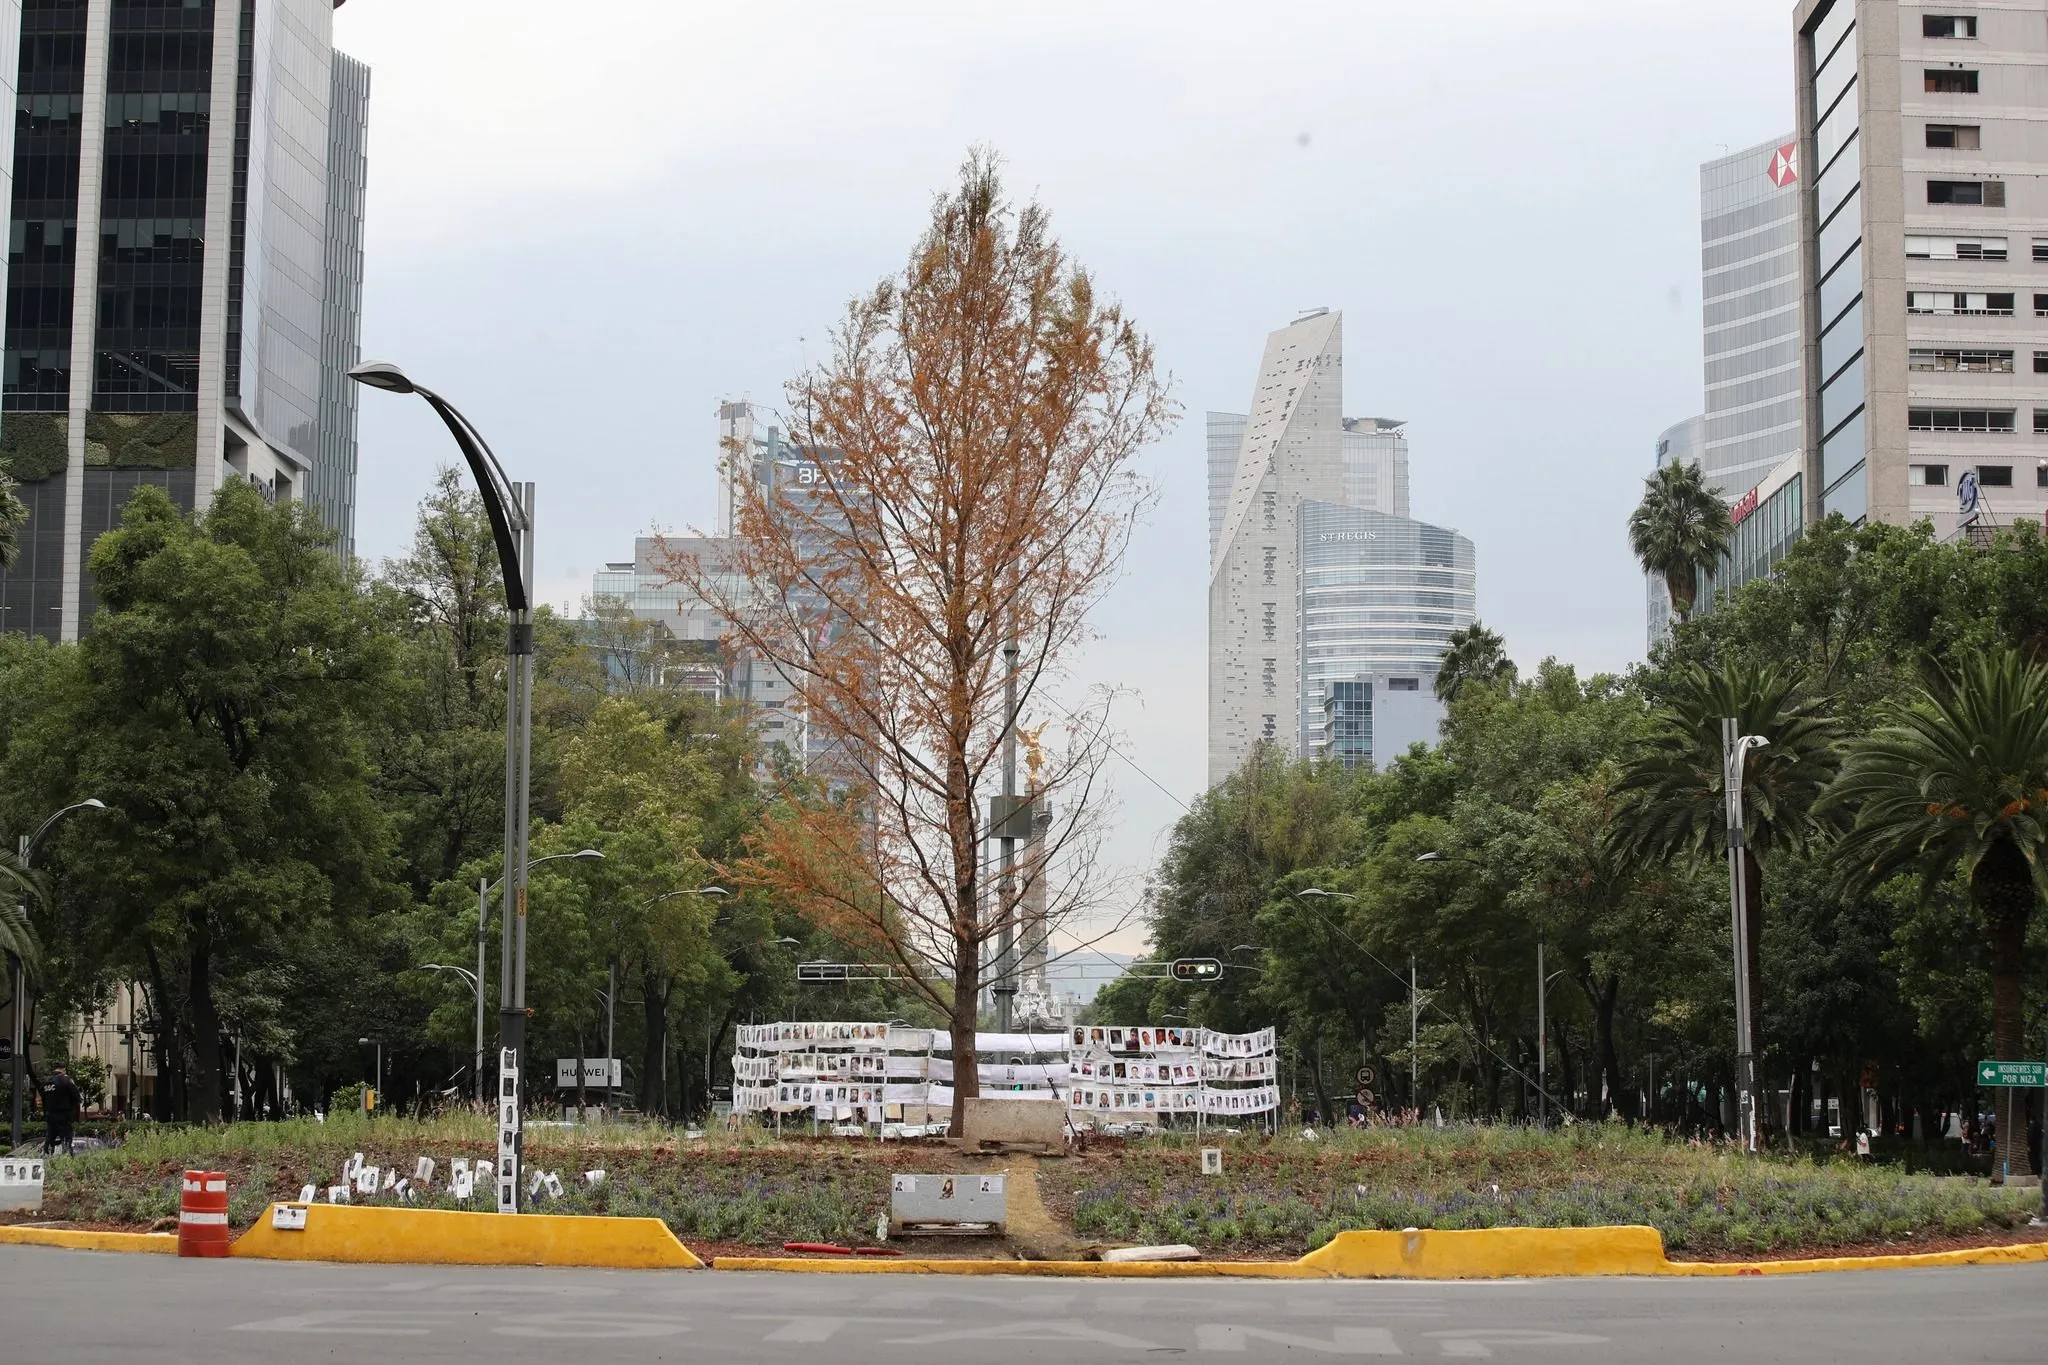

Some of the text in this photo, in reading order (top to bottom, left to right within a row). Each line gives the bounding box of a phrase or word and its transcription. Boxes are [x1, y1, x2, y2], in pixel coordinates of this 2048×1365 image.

[1337, 531, 1376, 540] REGIS
[561, 1068, 605, 1077] HUWEI
[1997, 1064, 2042, 1074] INSURGENTES SUR
[2002, 1074, 2038, 1084] POR NIZA
[44, 1084, 56, 1092] SSC
